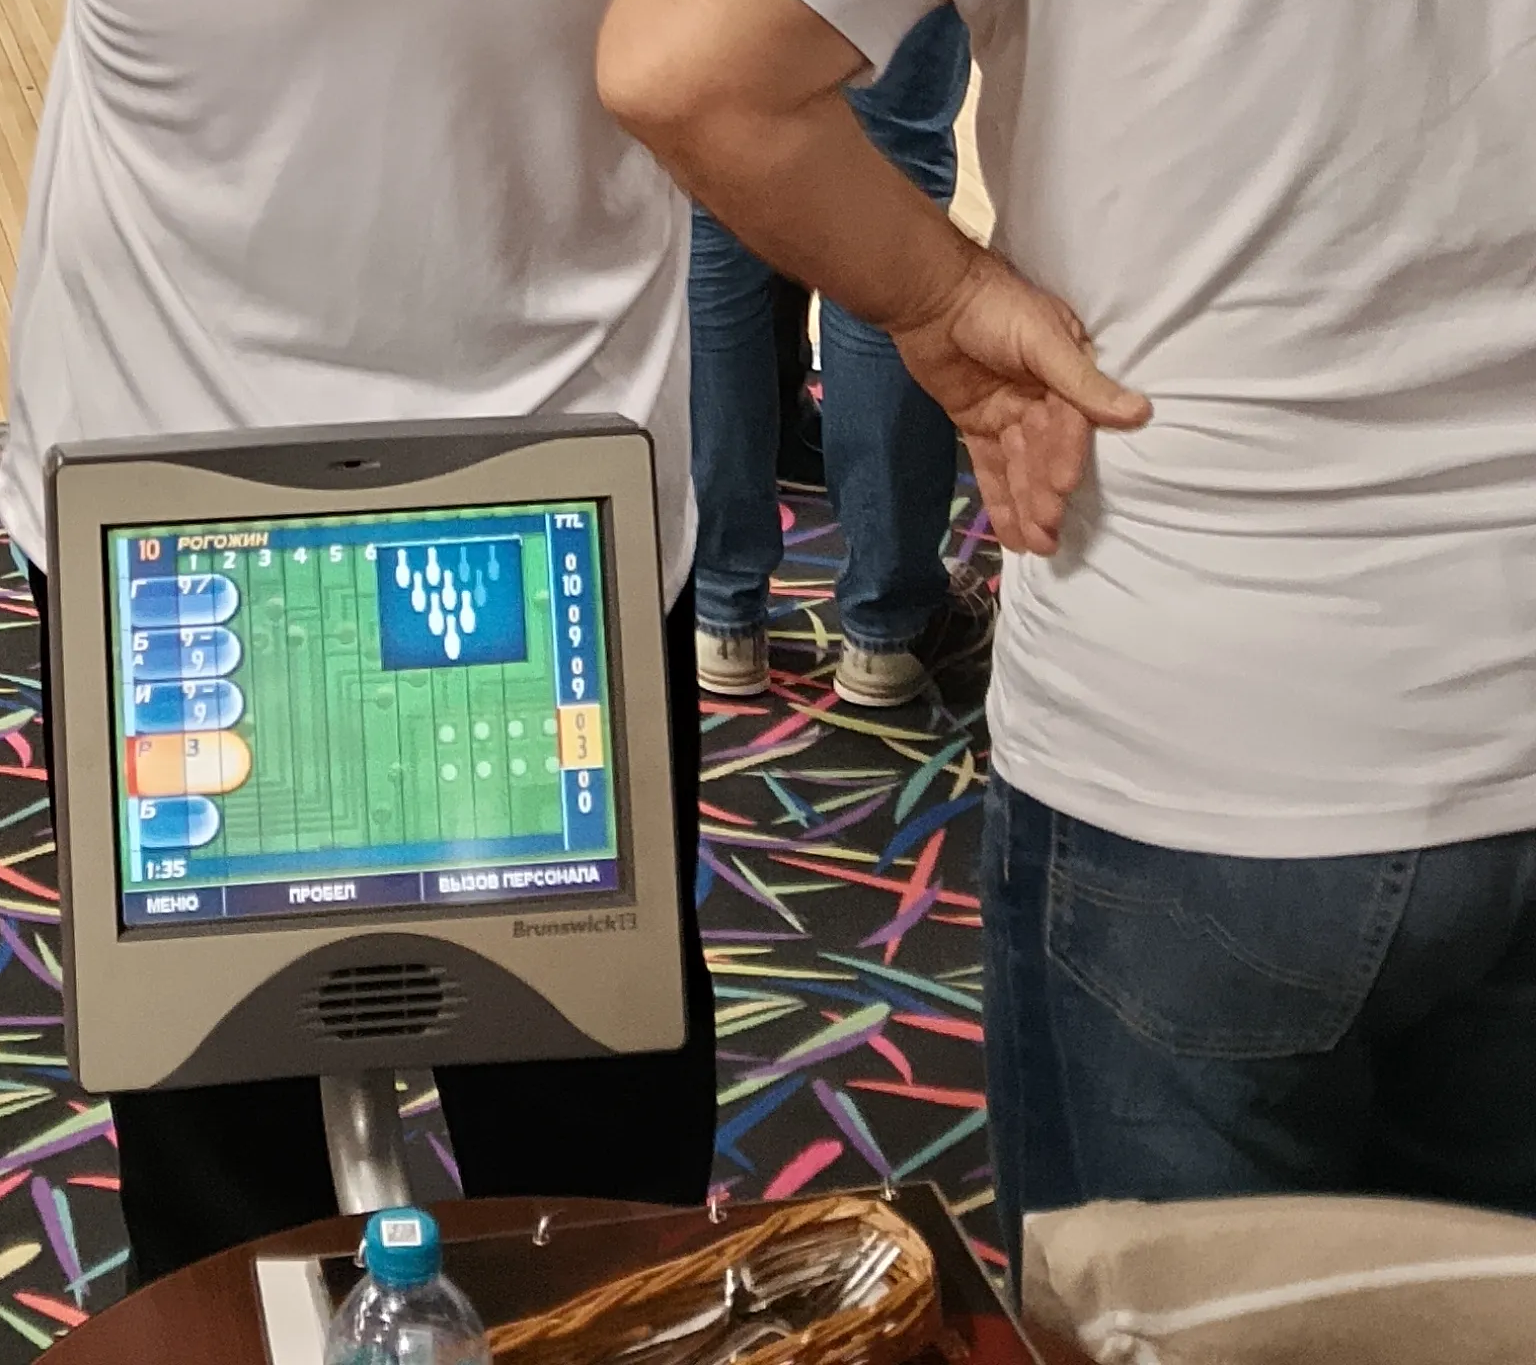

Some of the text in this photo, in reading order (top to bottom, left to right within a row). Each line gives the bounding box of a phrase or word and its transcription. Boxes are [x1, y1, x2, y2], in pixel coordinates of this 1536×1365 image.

[554, 513, 584, 529] TTL
[138, 539, 160, 561] 10
[177, 532, 269, 551] РОГОЖИН
[190, 544, 378, 571] 1 2 3 4 5 6
[565, 553, 577, 571] 0
[562, 574, 583, 596] 10
[568, 605, 580, 623] 0
[133, 634, 149, 651] Б
[568, 626, 581, 647] 9
[192, 651, 204, 670] 9
[571, 657, 583, 674] 0
[135, 685, 151, 704] И
[571, 677, 584, 699] 9
[193, 704, 207, 724] 9
[575, 713, 585, 730] 0
[186, 739, 199, 757] 3
[577, 736, 587, 758] 3
[578, 770, 589, 787] 0
[140, 801, 157, 819] Б
[578, 790, 592, 813] 0
[146, 859, 187, 879] 1:35
[439, 865, 600, 893] ВЫЗОВ ПЕРСОНАЛА
[289, 881, 356, 904] ПРОБЕЛ
[146, 893, 199, 914] МЕНЮ
